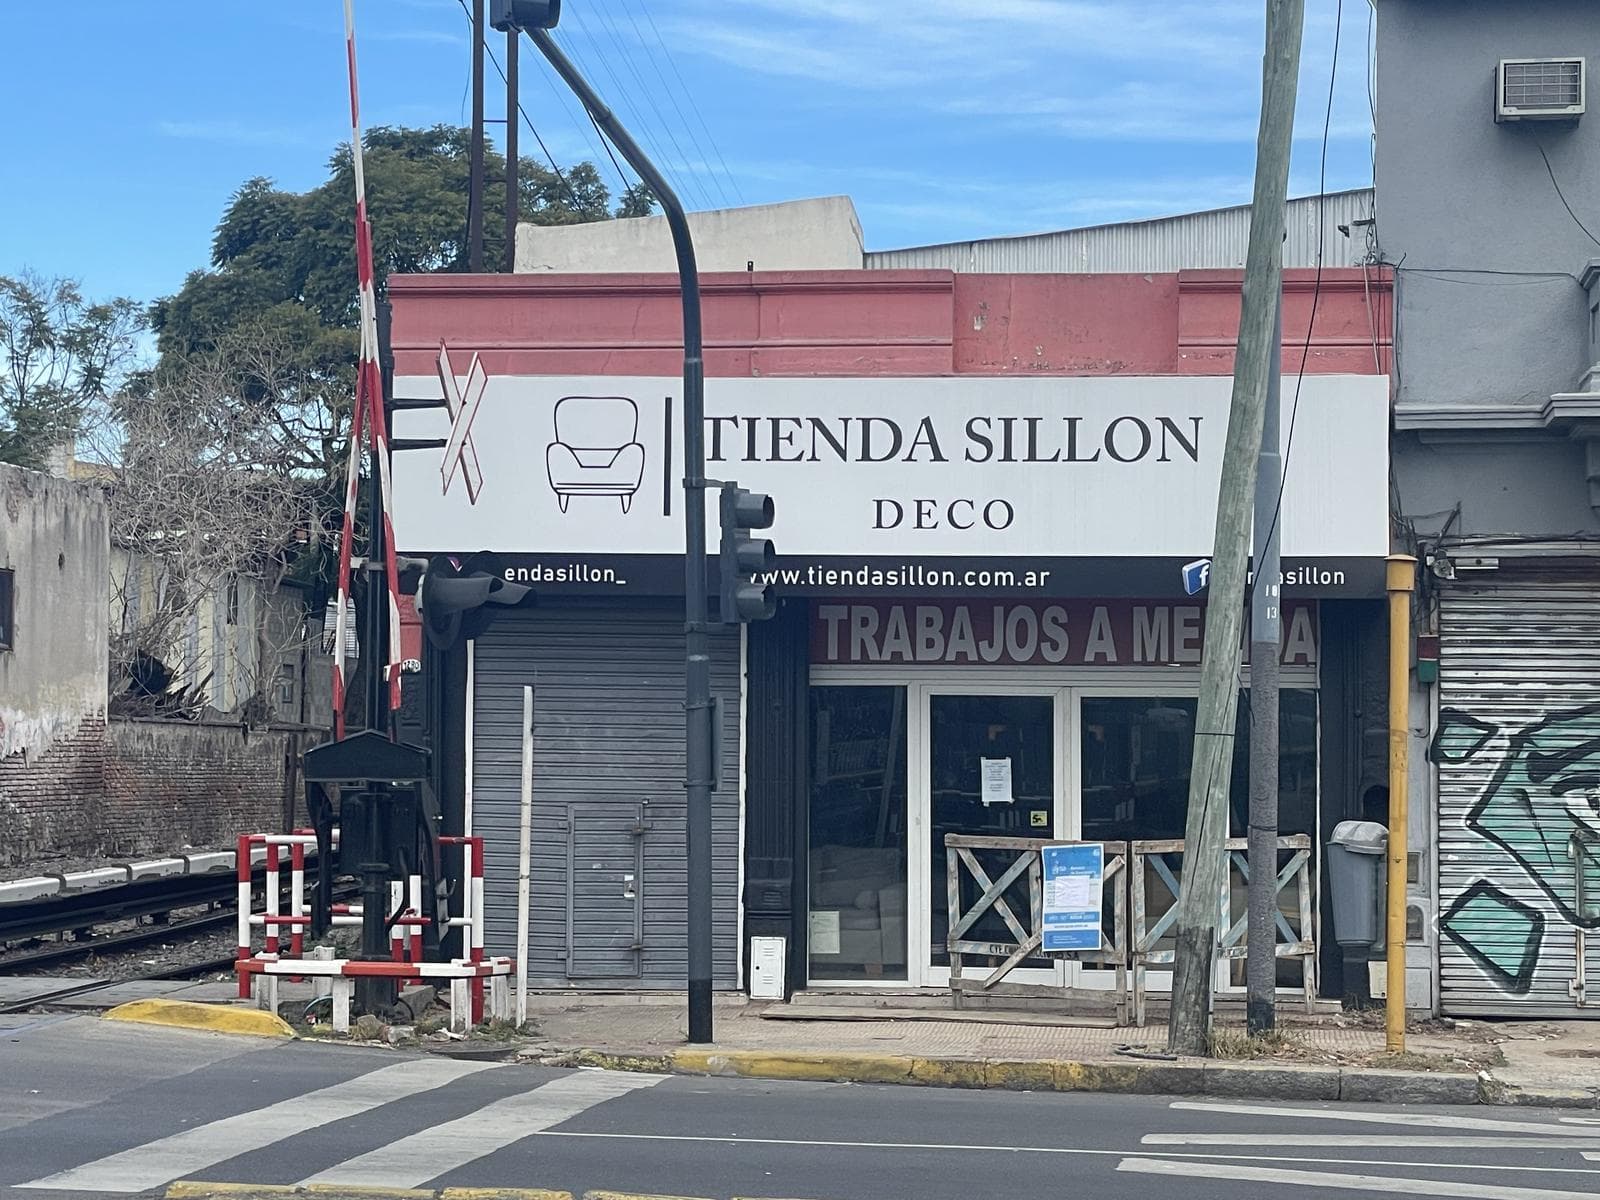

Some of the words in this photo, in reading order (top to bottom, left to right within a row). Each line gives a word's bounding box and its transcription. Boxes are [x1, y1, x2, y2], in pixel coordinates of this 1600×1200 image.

[703, 415, 950, 463] TIENDA
[964, 416, 1205, 463] SILLON
[872, 499, 1014, 530] DECO
[818, 604, 1070, 663] TRABAJOS
[1083, 606, 1119, 663] A
[1132, 606, 1317, 664] MEA
